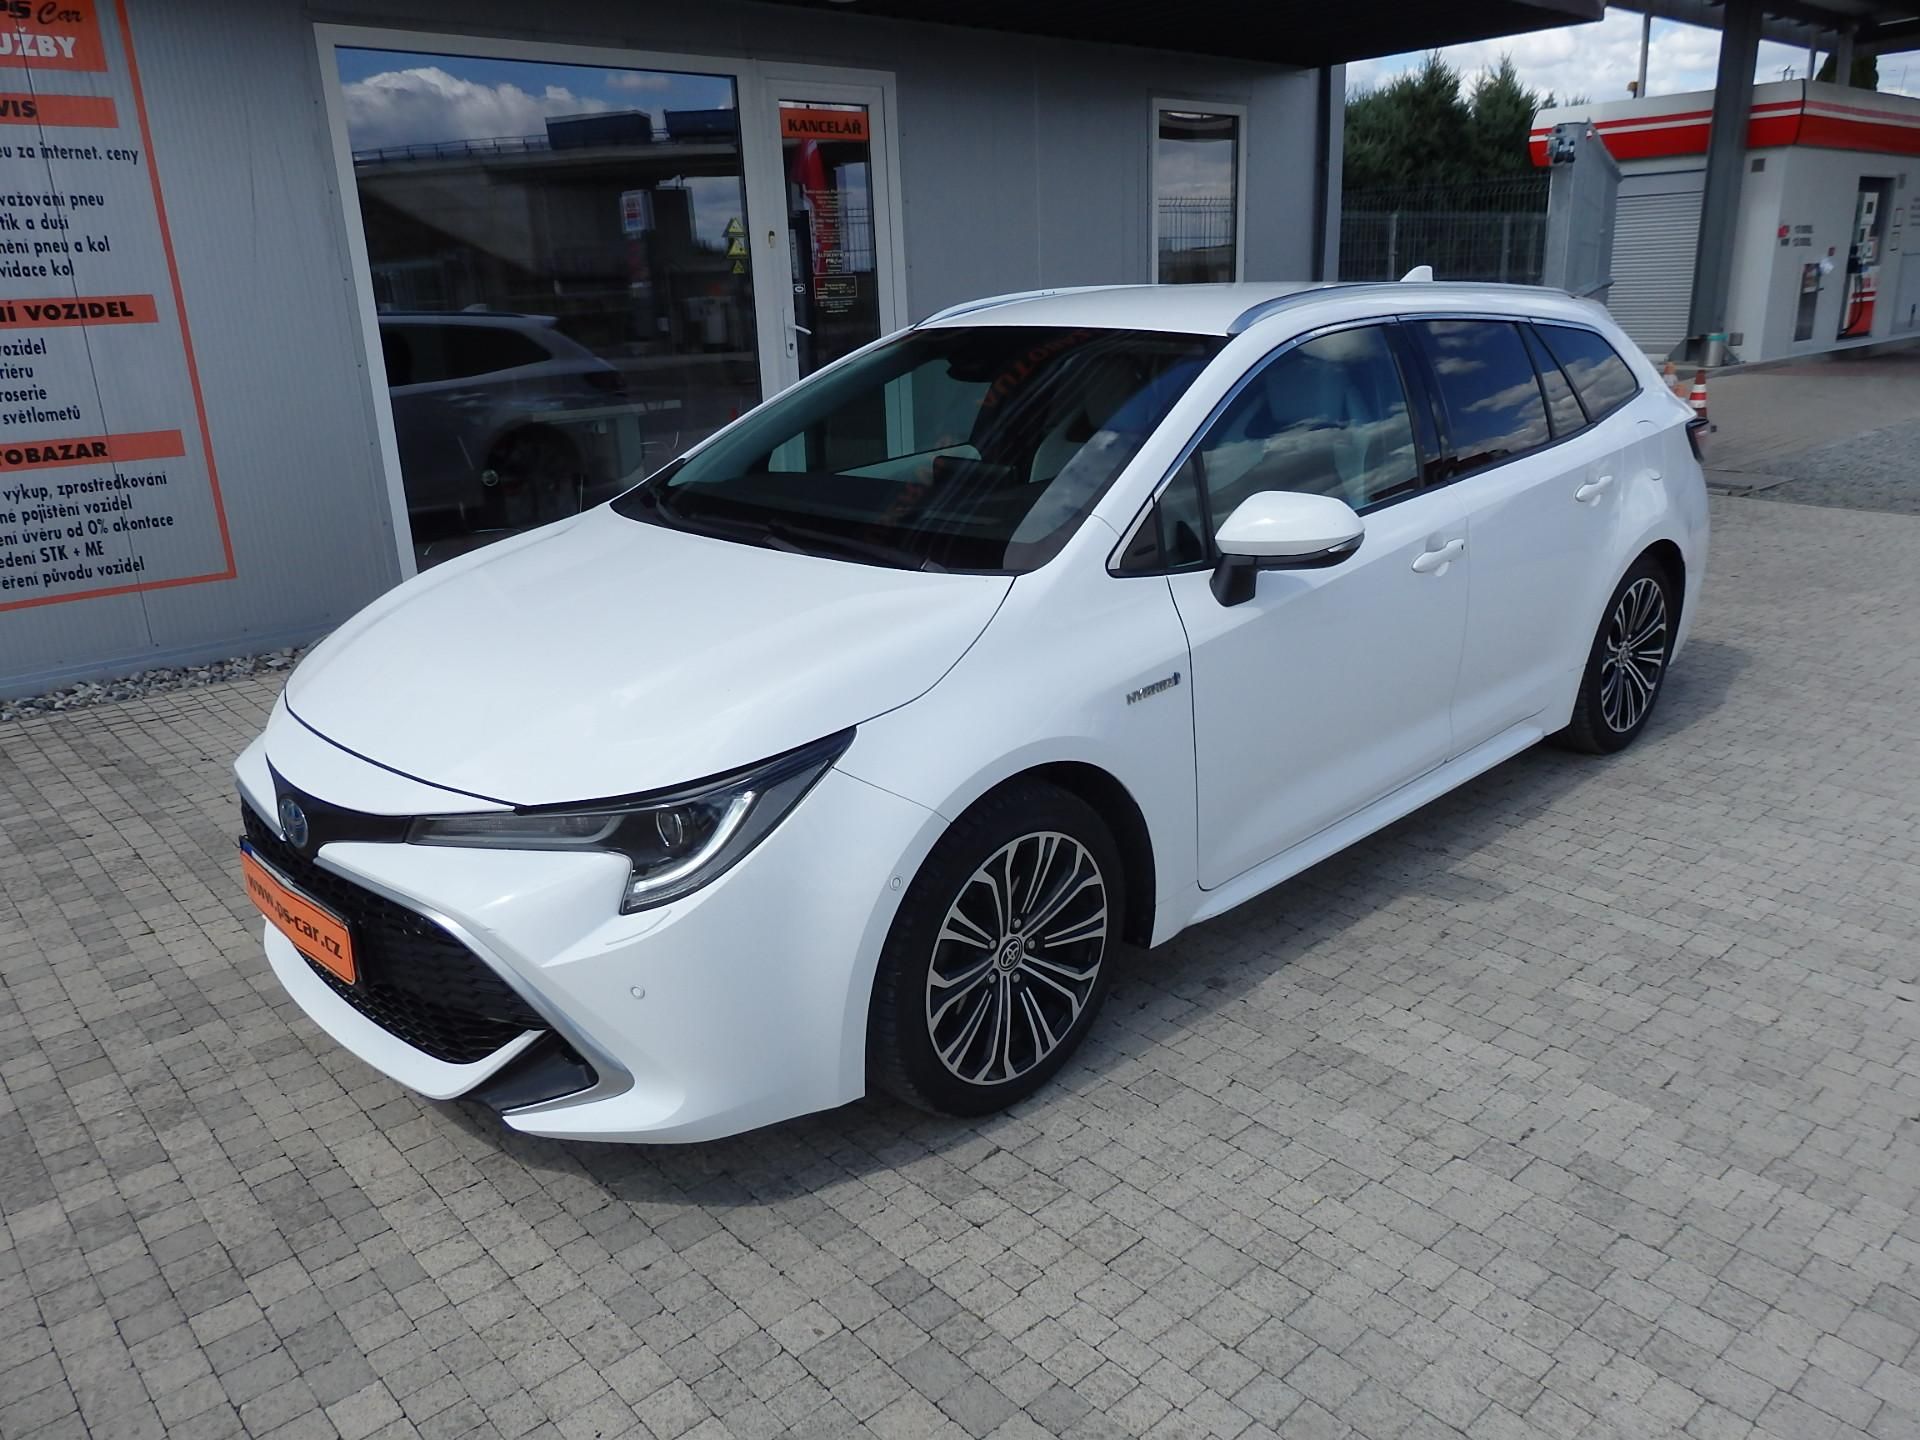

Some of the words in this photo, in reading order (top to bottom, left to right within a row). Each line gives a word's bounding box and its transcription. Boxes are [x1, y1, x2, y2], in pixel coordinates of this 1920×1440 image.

[0, 0, 32, 19] S
[37, 1, 83, 25] Car
[787, 118, 862, 134] KANCELÁŘ
[17, 146, 36, 158] za
[40, 141, 102, 160] internet.
[106, 149, 139, 165] ceny
[70, 195, 105, 210] pneu
[26, 219, 35, 230] a
[34, 241, 69, 257] pneu
[74, 242, 83, 253] a
[86, 235, 111, 252] kol
[50, 258, 75, 276] kol
[23, 301, 135, 321] VOZIDEL
[0, 338, 47, 356] ozidel
[3, 405, 81, 425] světlometů
[0, 442, 109, 466] OBAZAR
[3, 483, 53, 504] výkup,
[57, 471, 168, 498] zprostředkování
[22, 502, 80, 525] pojištění
[84, 494, 133, 514] vozidel
[22, 528, 62, 544] úvěru
[67, 521, 84, 538] od
[88, 518, 109, 535] 0%
[113, 514, 174, 532] akontace
[40, 544, 69, 563] STK
[73, 549, 81, 557] +
[85, 540, 105, 557] ME
[43, 563, 93, 588] původu
[97, 556, 145, 576] vozidel
[247, 873, 343, 960] www.ps-car.cz
